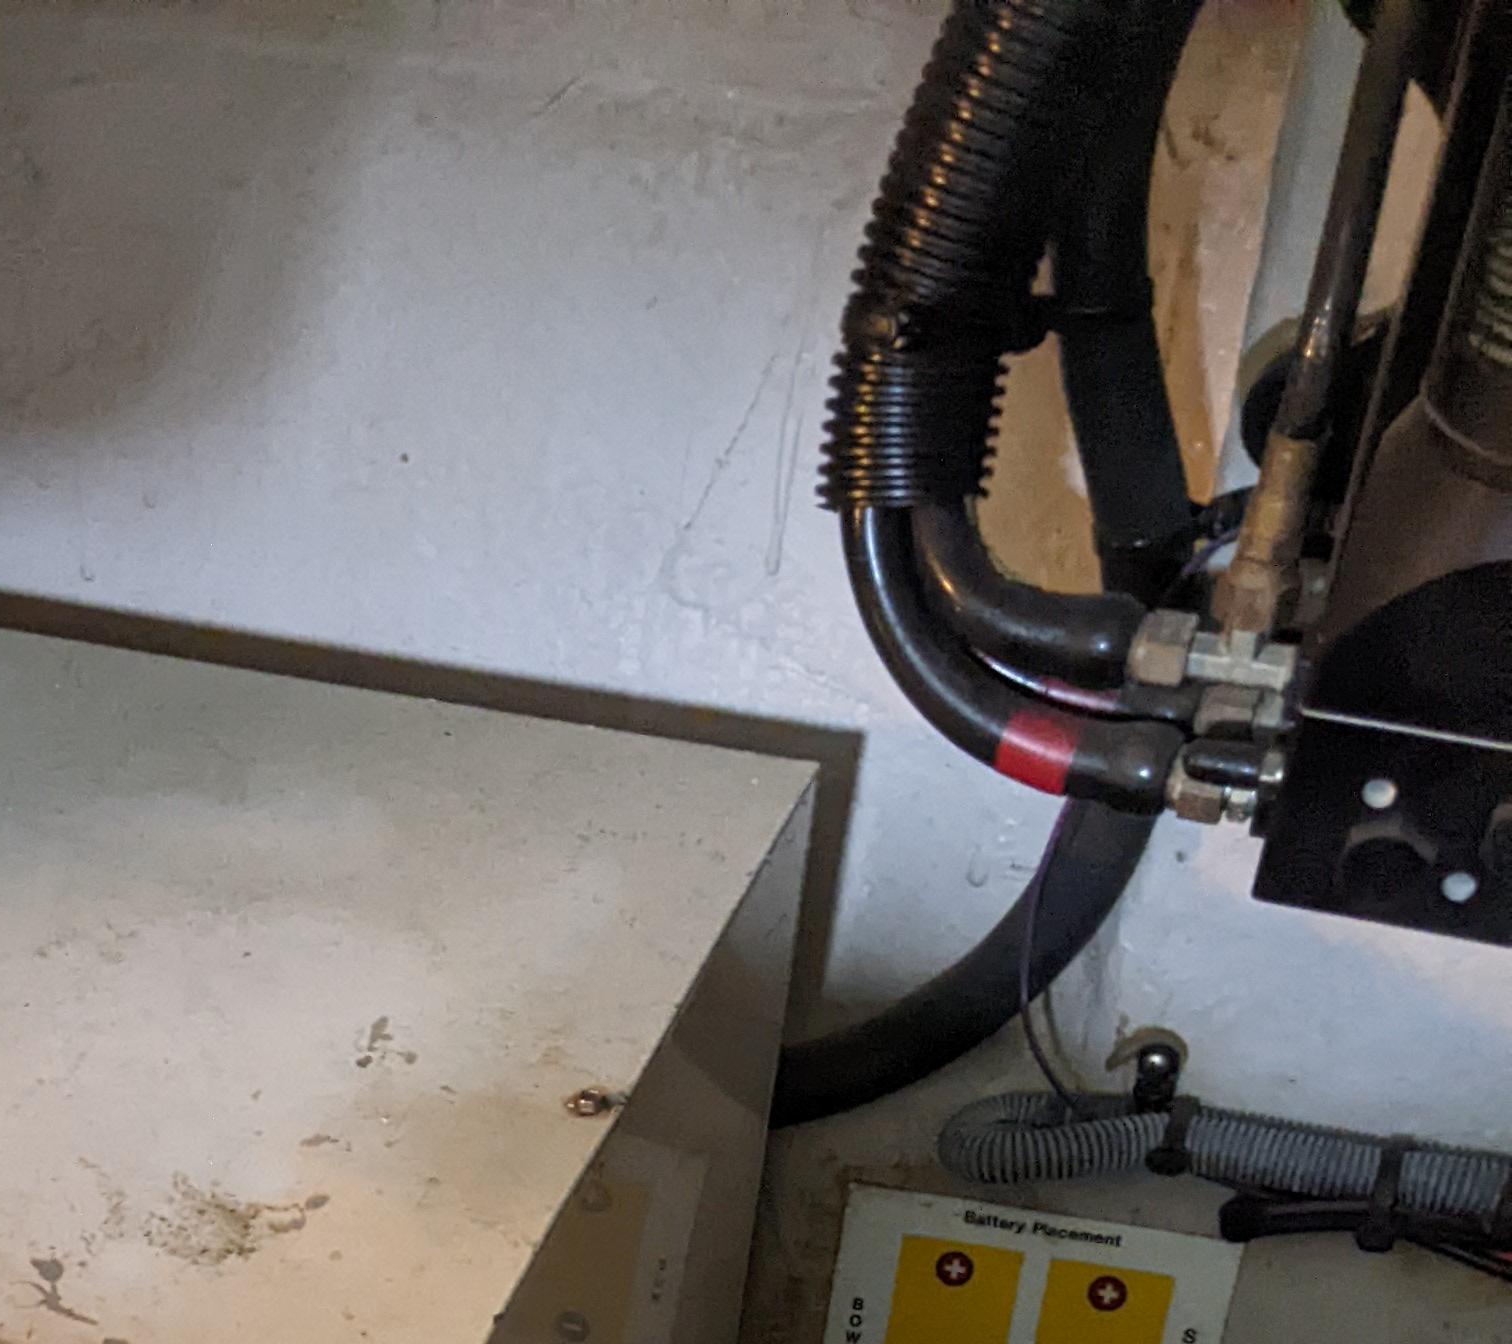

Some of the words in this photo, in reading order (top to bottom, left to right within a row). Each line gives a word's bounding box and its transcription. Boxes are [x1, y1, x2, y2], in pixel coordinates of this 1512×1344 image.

[964, 1210, 1026, 1234] Battery
[1033, 1222, 1123, 1248] Placement
[846, 1298, 865, 1344] BOW
